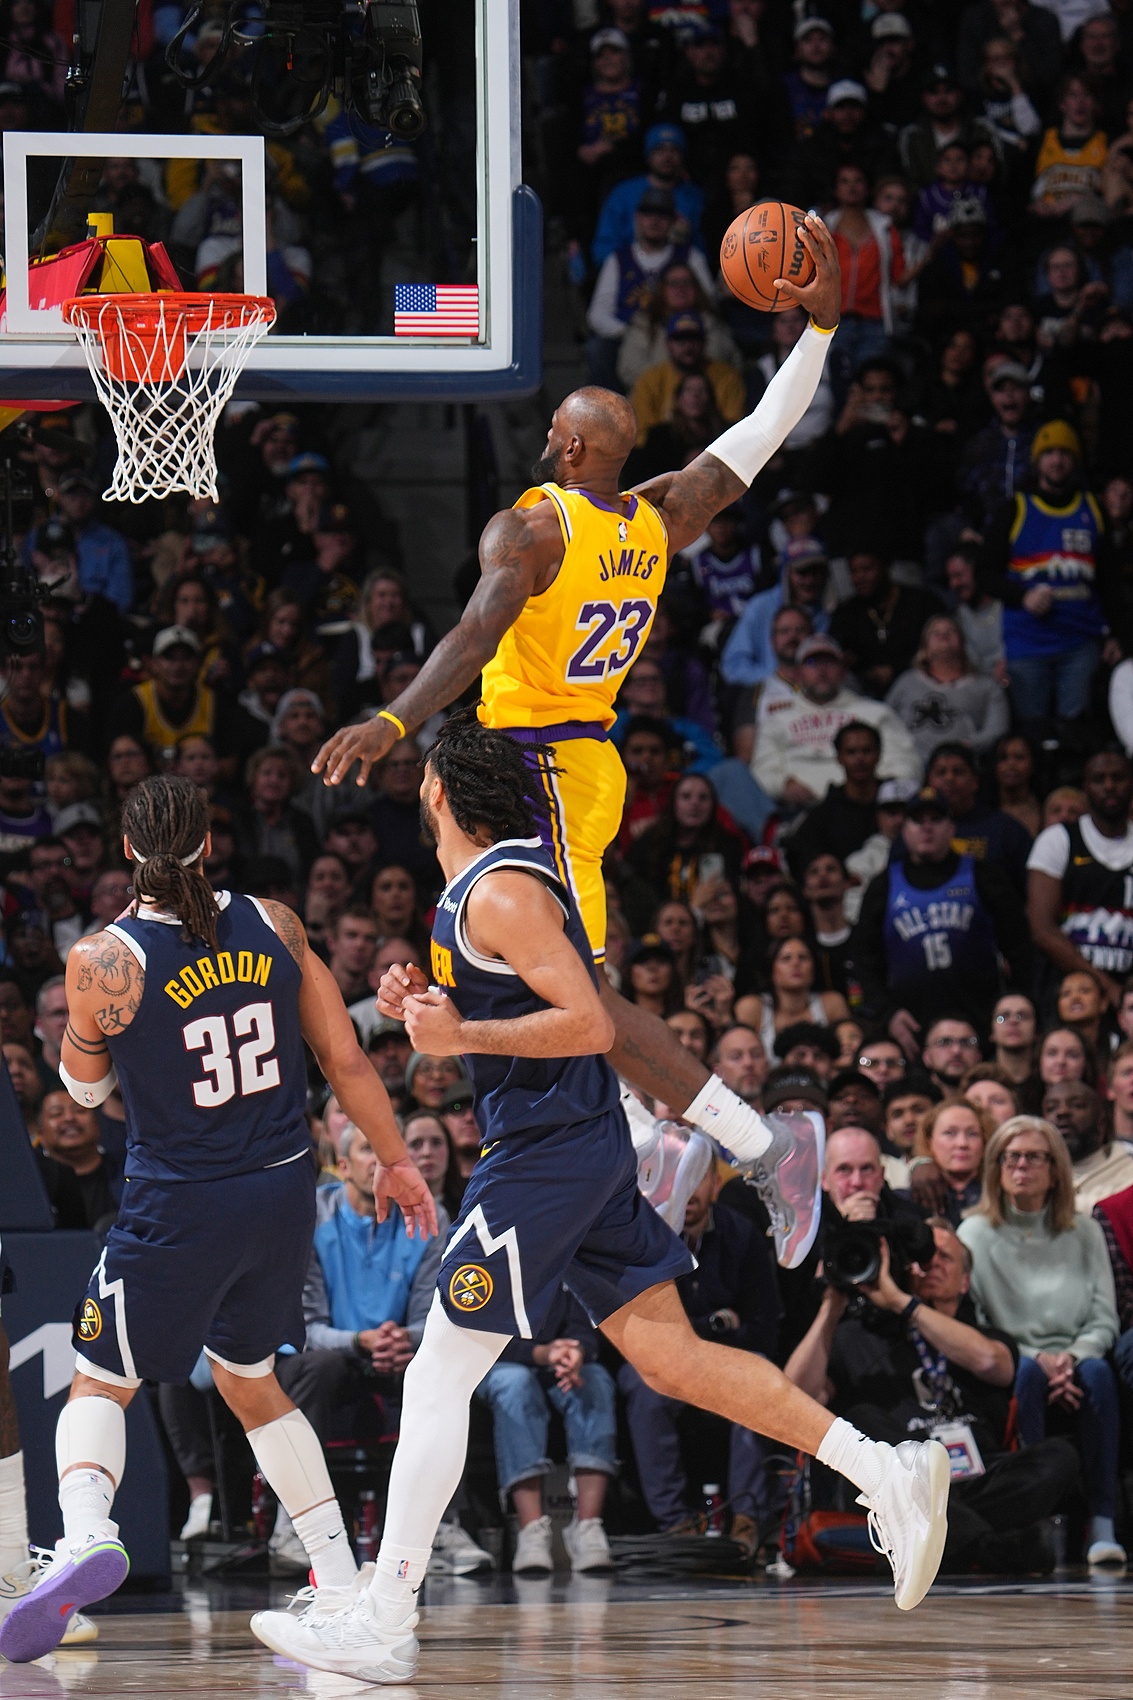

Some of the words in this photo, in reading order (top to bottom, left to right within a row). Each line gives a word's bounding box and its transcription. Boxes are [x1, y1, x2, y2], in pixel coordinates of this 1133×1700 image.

[788, 210, 807, 277] Wson
[598, 549, 659, 582] JAMES
[565, 598, 655, 684] 23
[164, 951, 273, 1009] GORDON
[181, 1000, 281, 1108] 32
